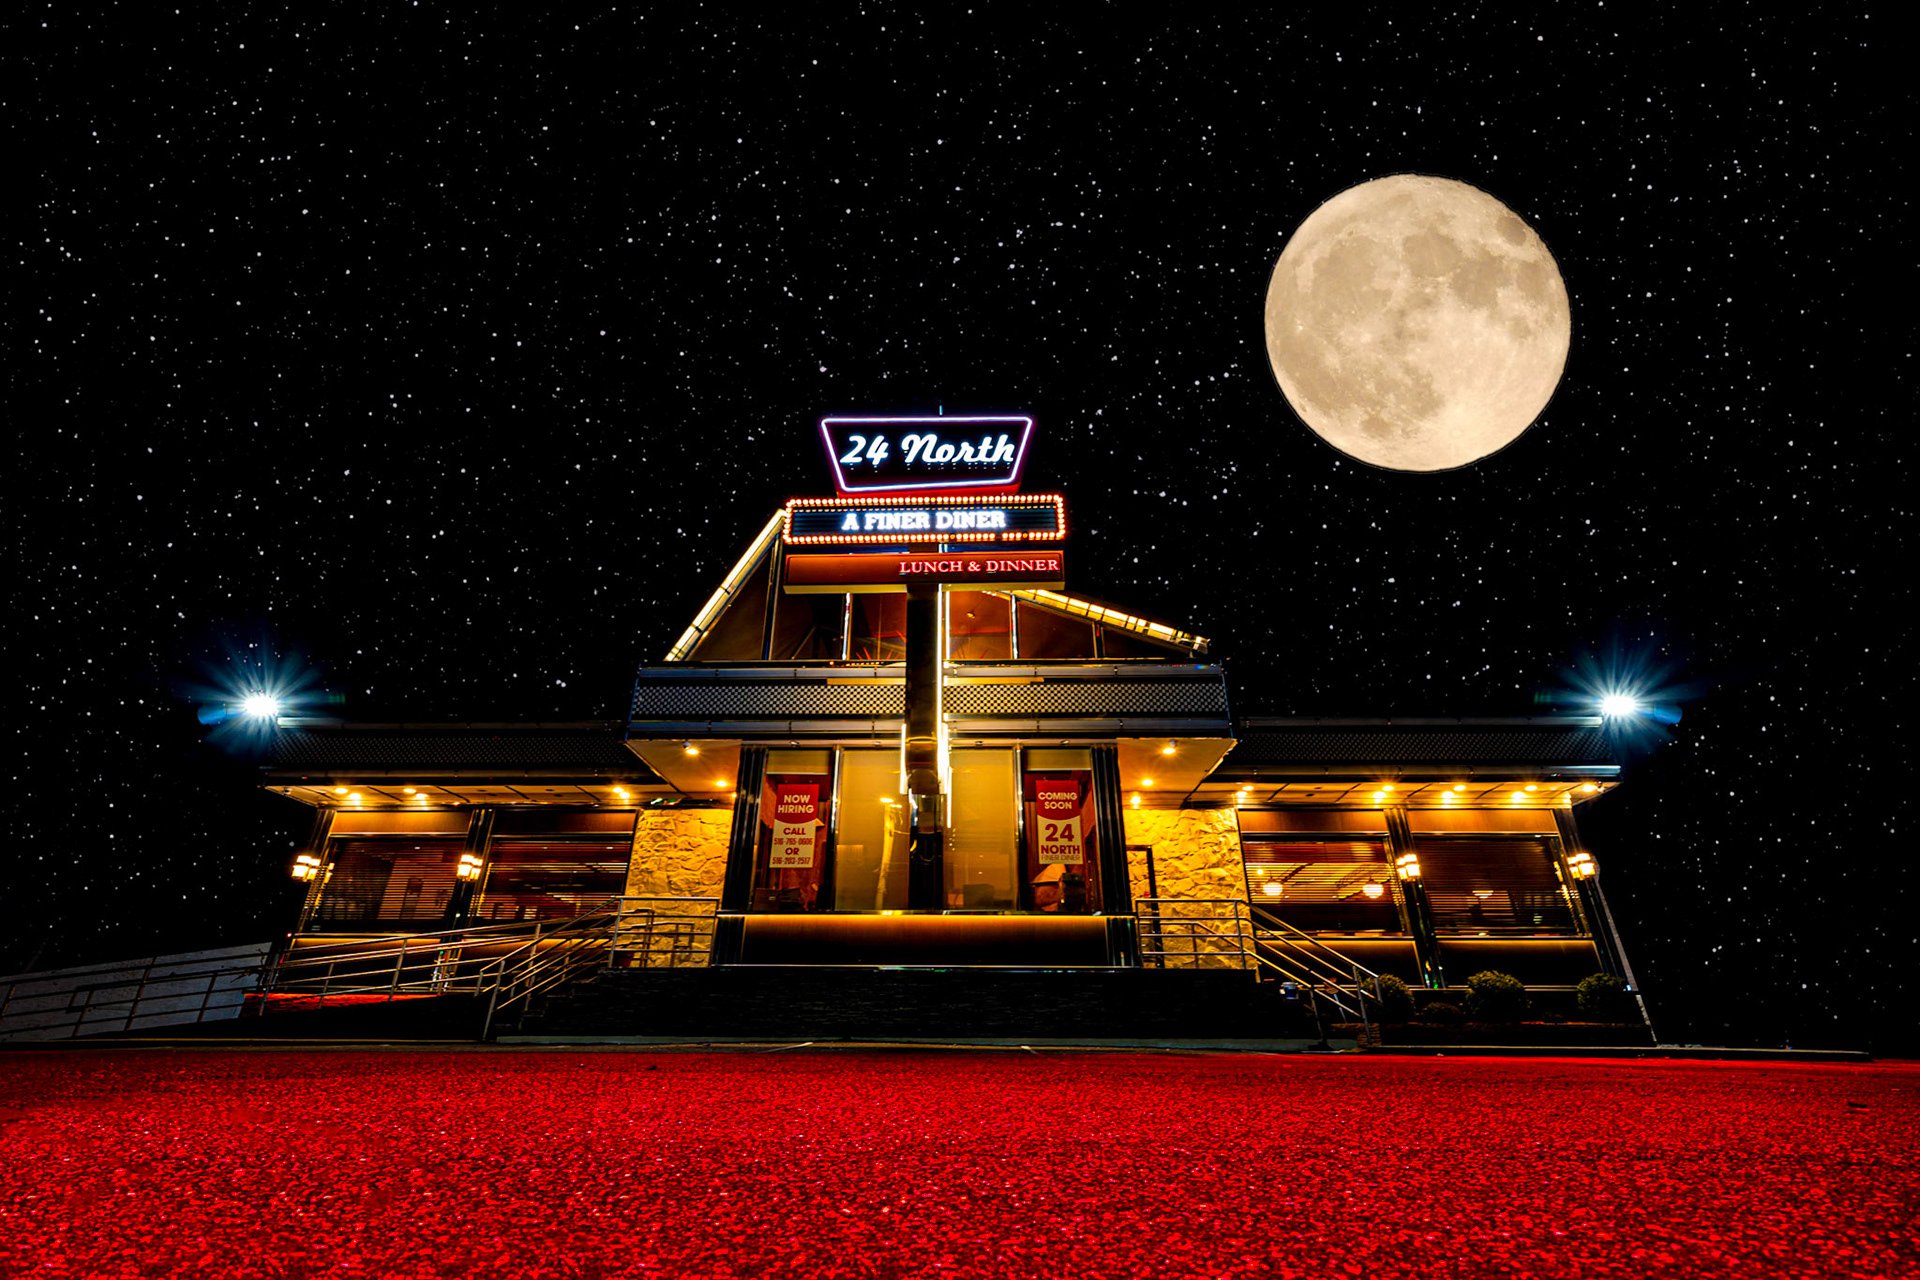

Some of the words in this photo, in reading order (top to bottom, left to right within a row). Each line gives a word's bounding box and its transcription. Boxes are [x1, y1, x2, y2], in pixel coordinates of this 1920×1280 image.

[840, 435, 889, 465] 24
[901, 433, 1016, 463] North
[841, 513, 860, 531] A
[864, 512, 931, 531] FINER
[935, 510, 1006, 530] DINER
[900, 560, 963, 574] LUNCH
[968, 561, 981, 573] &
[985, 559, 1061, 573] DINNER
[784, 795, 810, 803] NOW
[1038, 792, 1077, 800] COMING
[778, 805, 814, 813] HIRING
[1045, 823, 1074, 842] 24
[1041, 845, 1080, 854] NORTH
